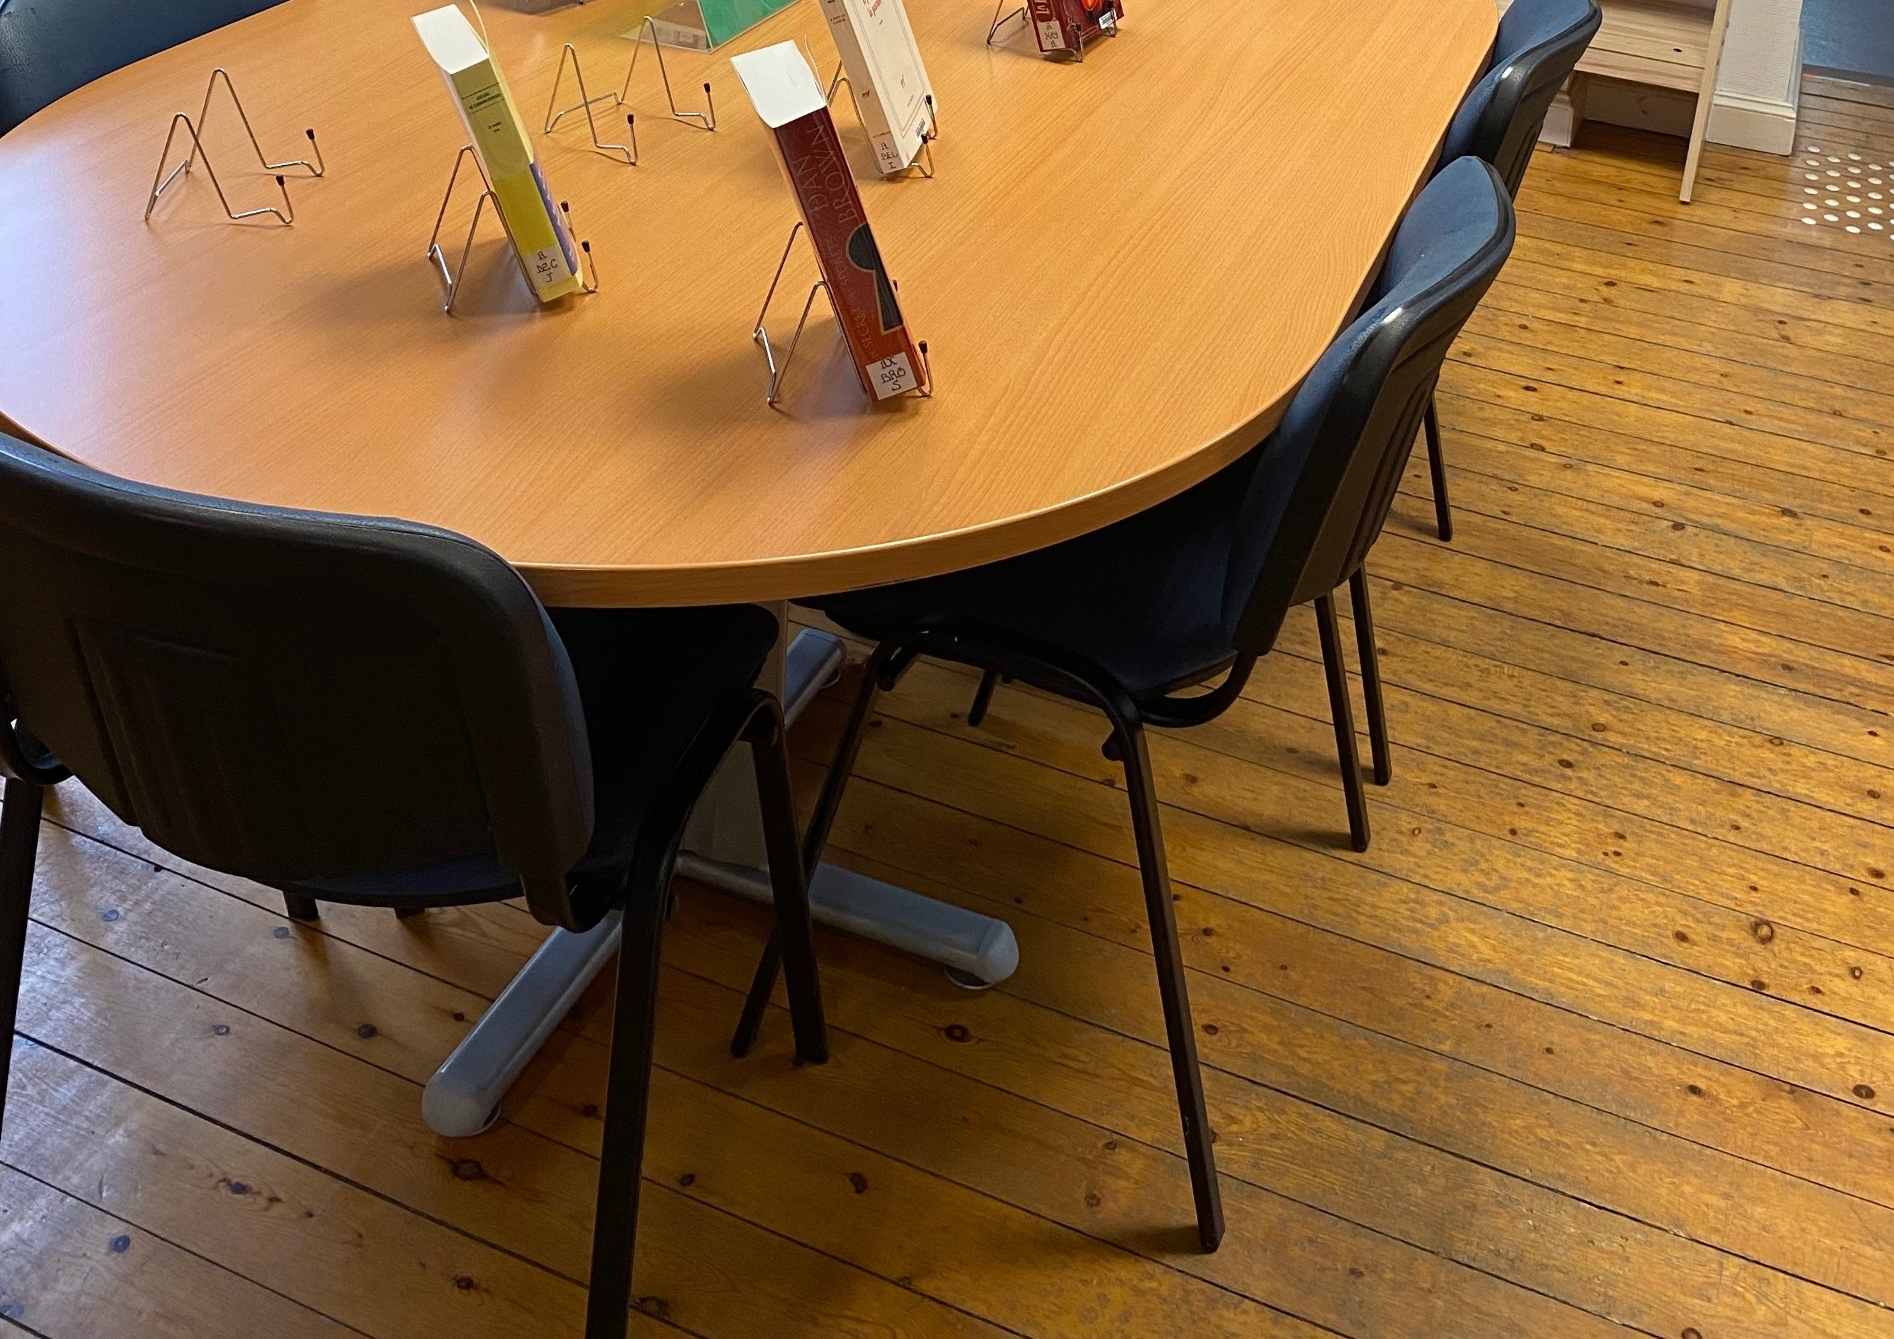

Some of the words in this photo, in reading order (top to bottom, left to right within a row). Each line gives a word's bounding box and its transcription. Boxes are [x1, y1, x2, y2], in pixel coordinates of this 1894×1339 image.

[881, 152, 898, 160] BEL
[806, 123, 860, 225] BROWN
[792, 153, 831, 215] DAN
[536, 259, 558, 273] DEC
[881, 368, 906, 384] BRO
[892, 380, 901, 391] S
